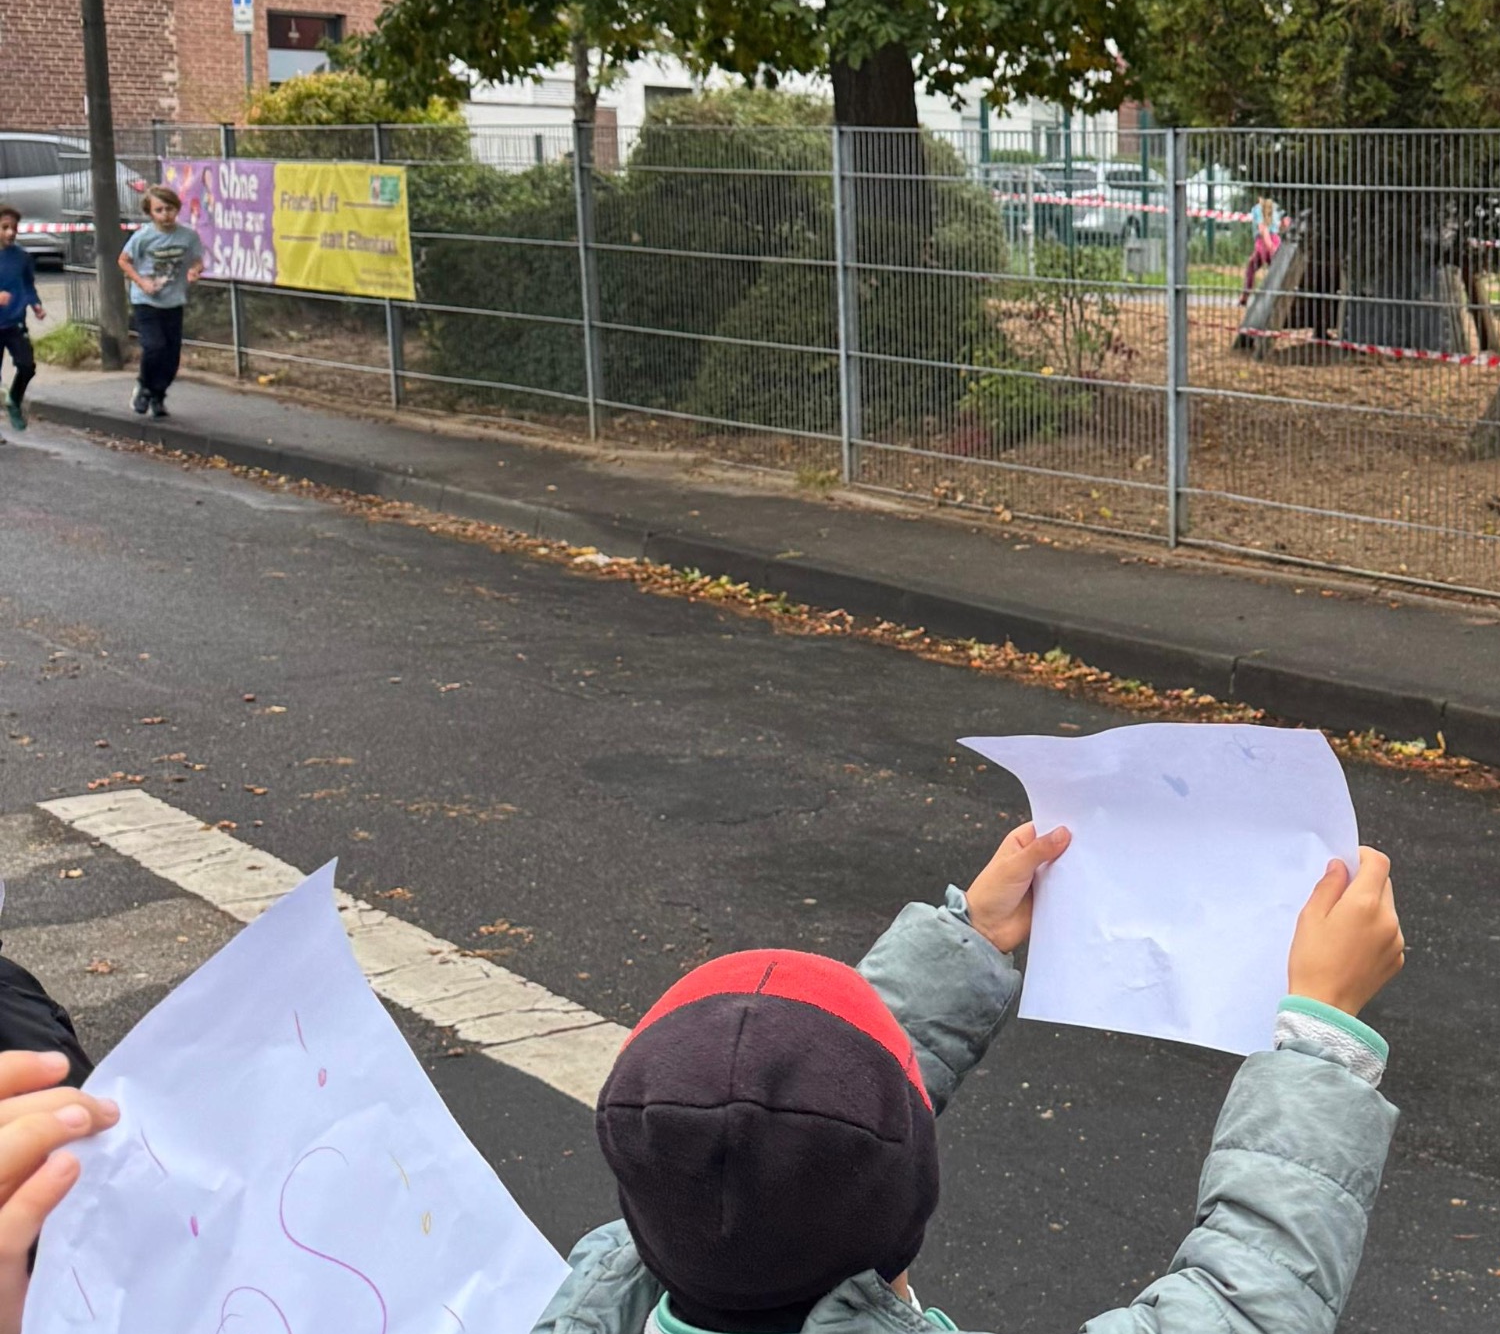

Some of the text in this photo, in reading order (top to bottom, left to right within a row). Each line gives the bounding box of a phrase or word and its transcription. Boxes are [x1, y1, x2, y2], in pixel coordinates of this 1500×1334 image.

[219, 162, 258, 200] Ohne
[214, 201, 265, 232] Auto zur
[213, 233, 274, 281] Schule
